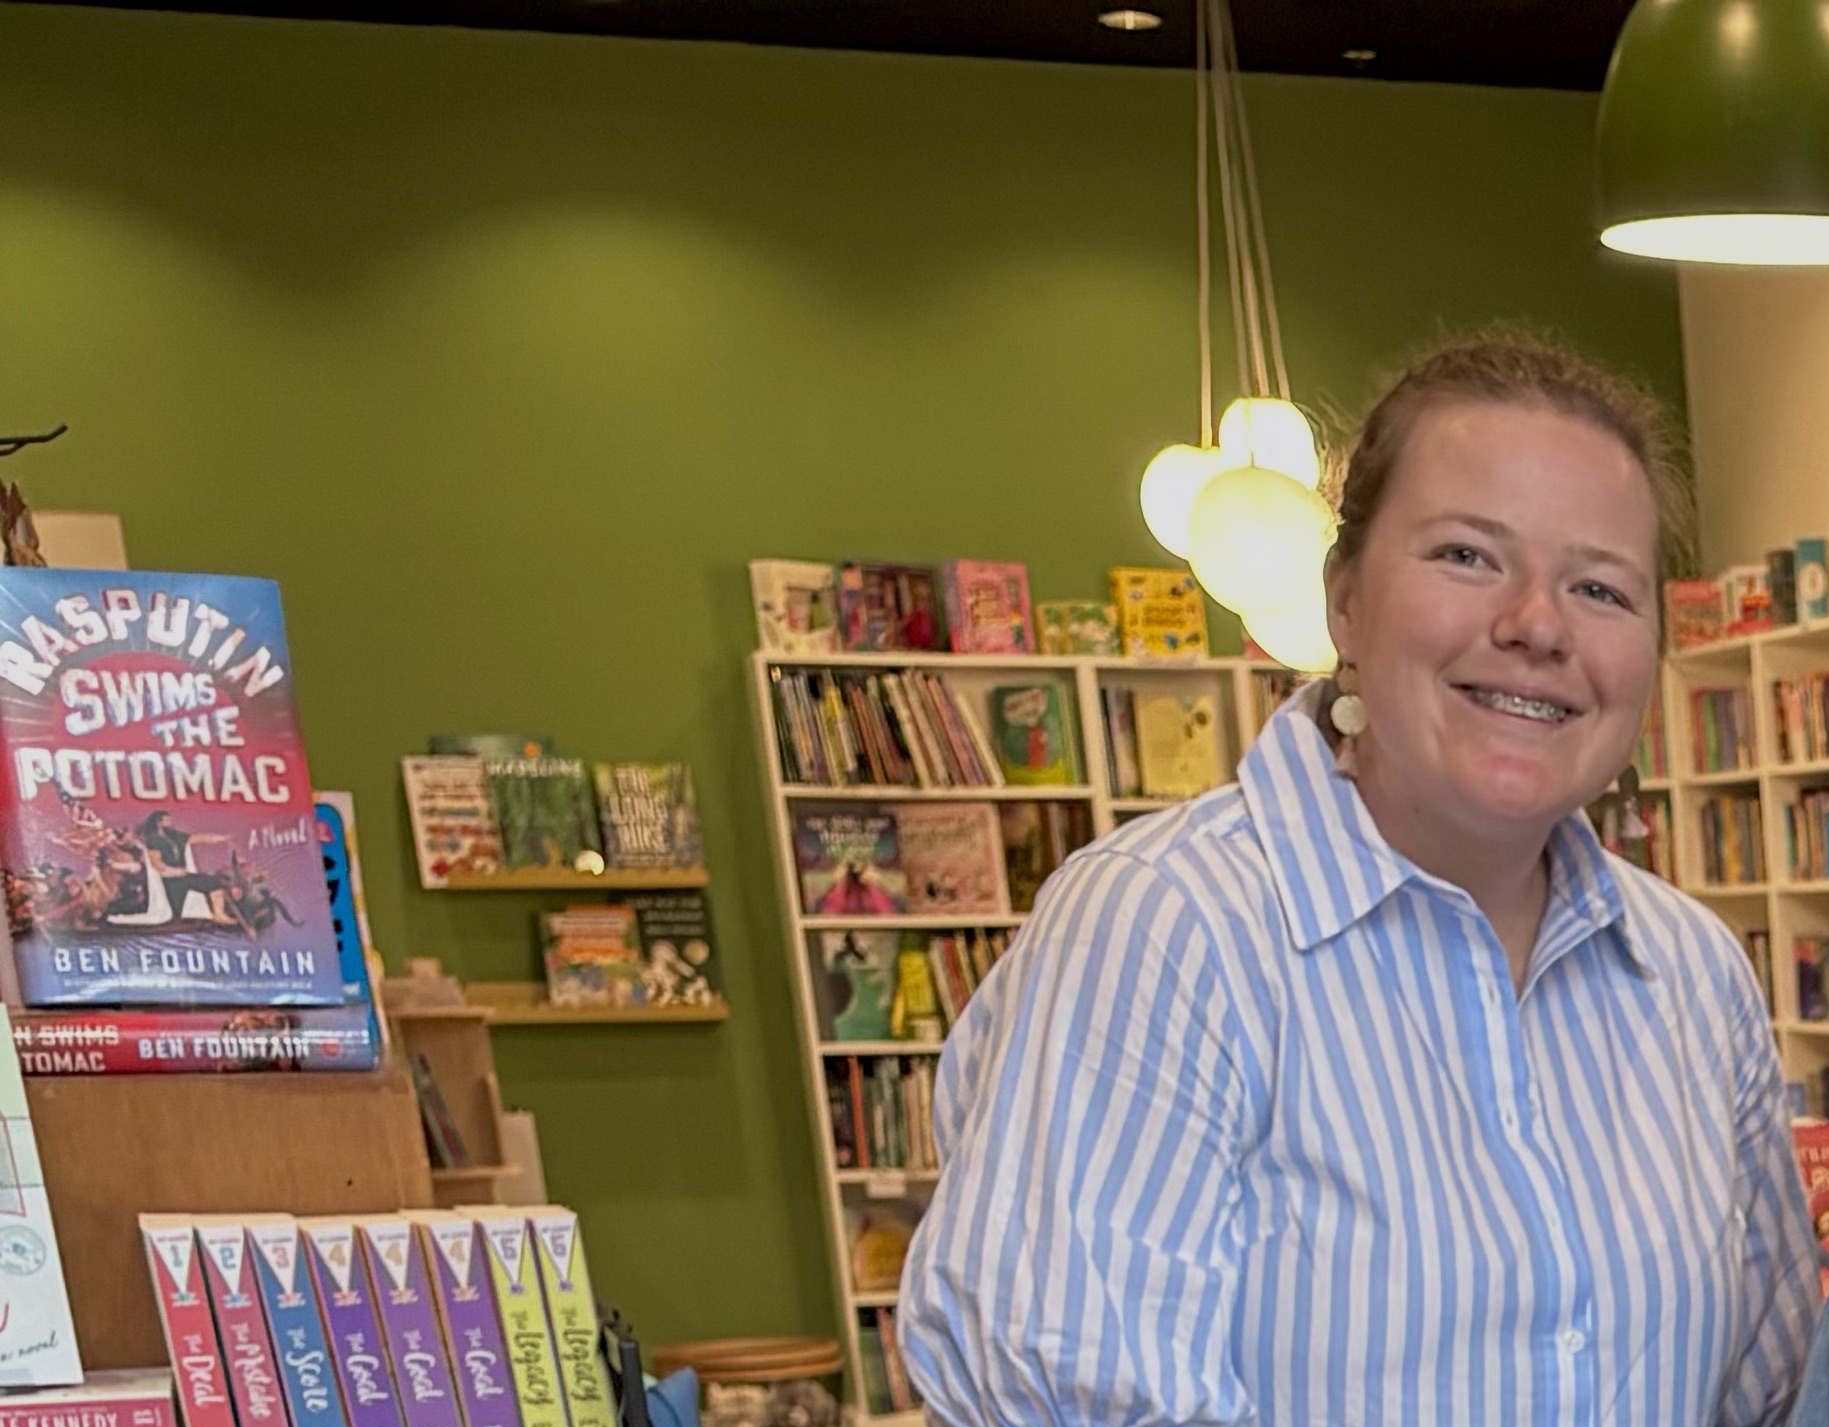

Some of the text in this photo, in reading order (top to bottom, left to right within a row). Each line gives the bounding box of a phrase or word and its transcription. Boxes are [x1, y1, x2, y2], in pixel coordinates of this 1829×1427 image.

[0, 588, 285, 697] RASPUTIN
[60, 669, 217, 736] SWIMS
[151, 705, 246, 747] THE
[14, 746, 291, 804] POTOMAC
[54, 948, 316, 976] BEN FOUNTAIN
[36, 1023, 120, 1046] SWIMS
[138, 1036, 311, 1060] BEN FOUNTAIN
[22, 1051, 106, 1074] TOMAC
[219, 1246, 237, 1271] 2
[327, 1243, 347, 1268] 4
[384, 1242, 404, 1267] 4
[450, 1239, 467, 1264] 4
[18, 1330, 60, 1360] novel
